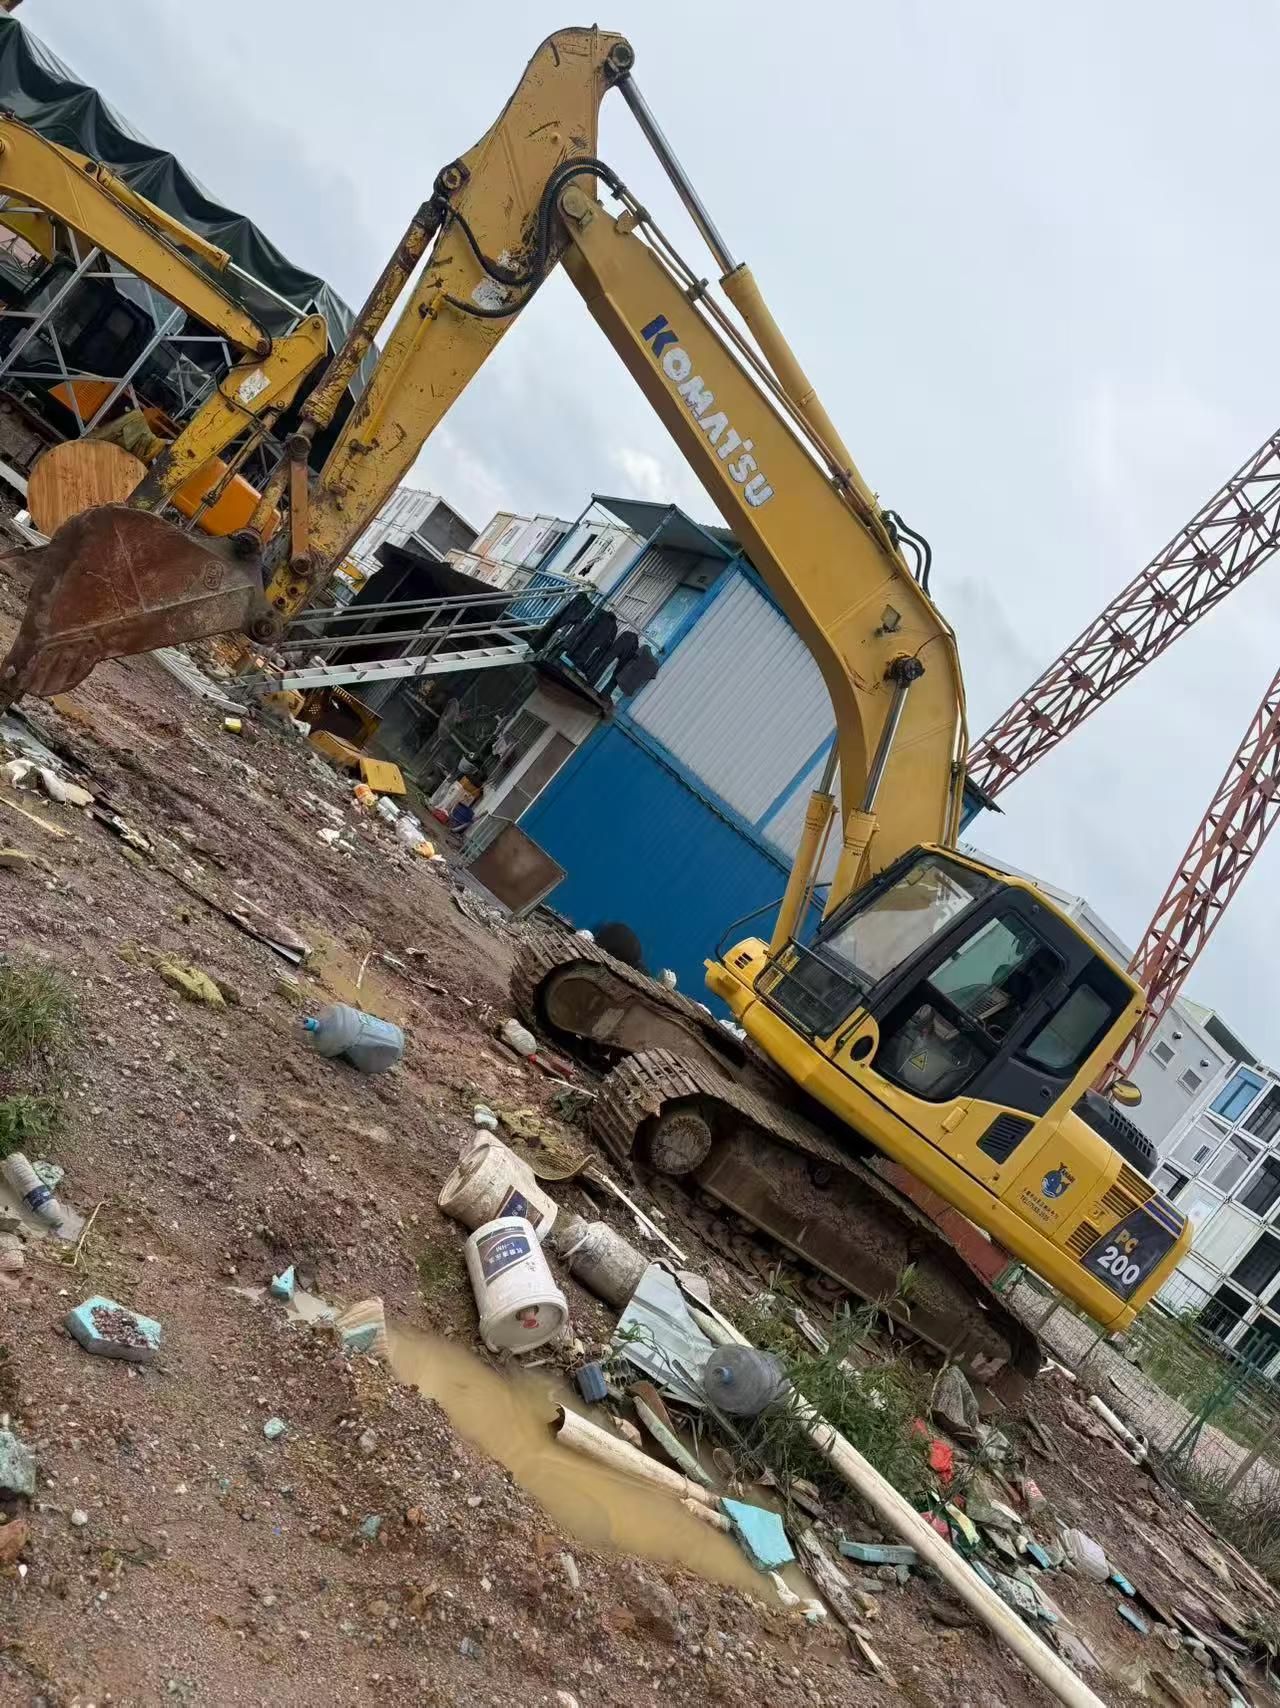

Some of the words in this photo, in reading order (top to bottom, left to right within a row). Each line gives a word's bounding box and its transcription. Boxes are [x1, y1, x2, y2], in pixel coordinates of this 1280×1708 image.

[640, 314, 775, 508] KOMATSU
[1114, 1229, 1139, 1253] PC
[1097, 1246, 1140, 1284] 200
